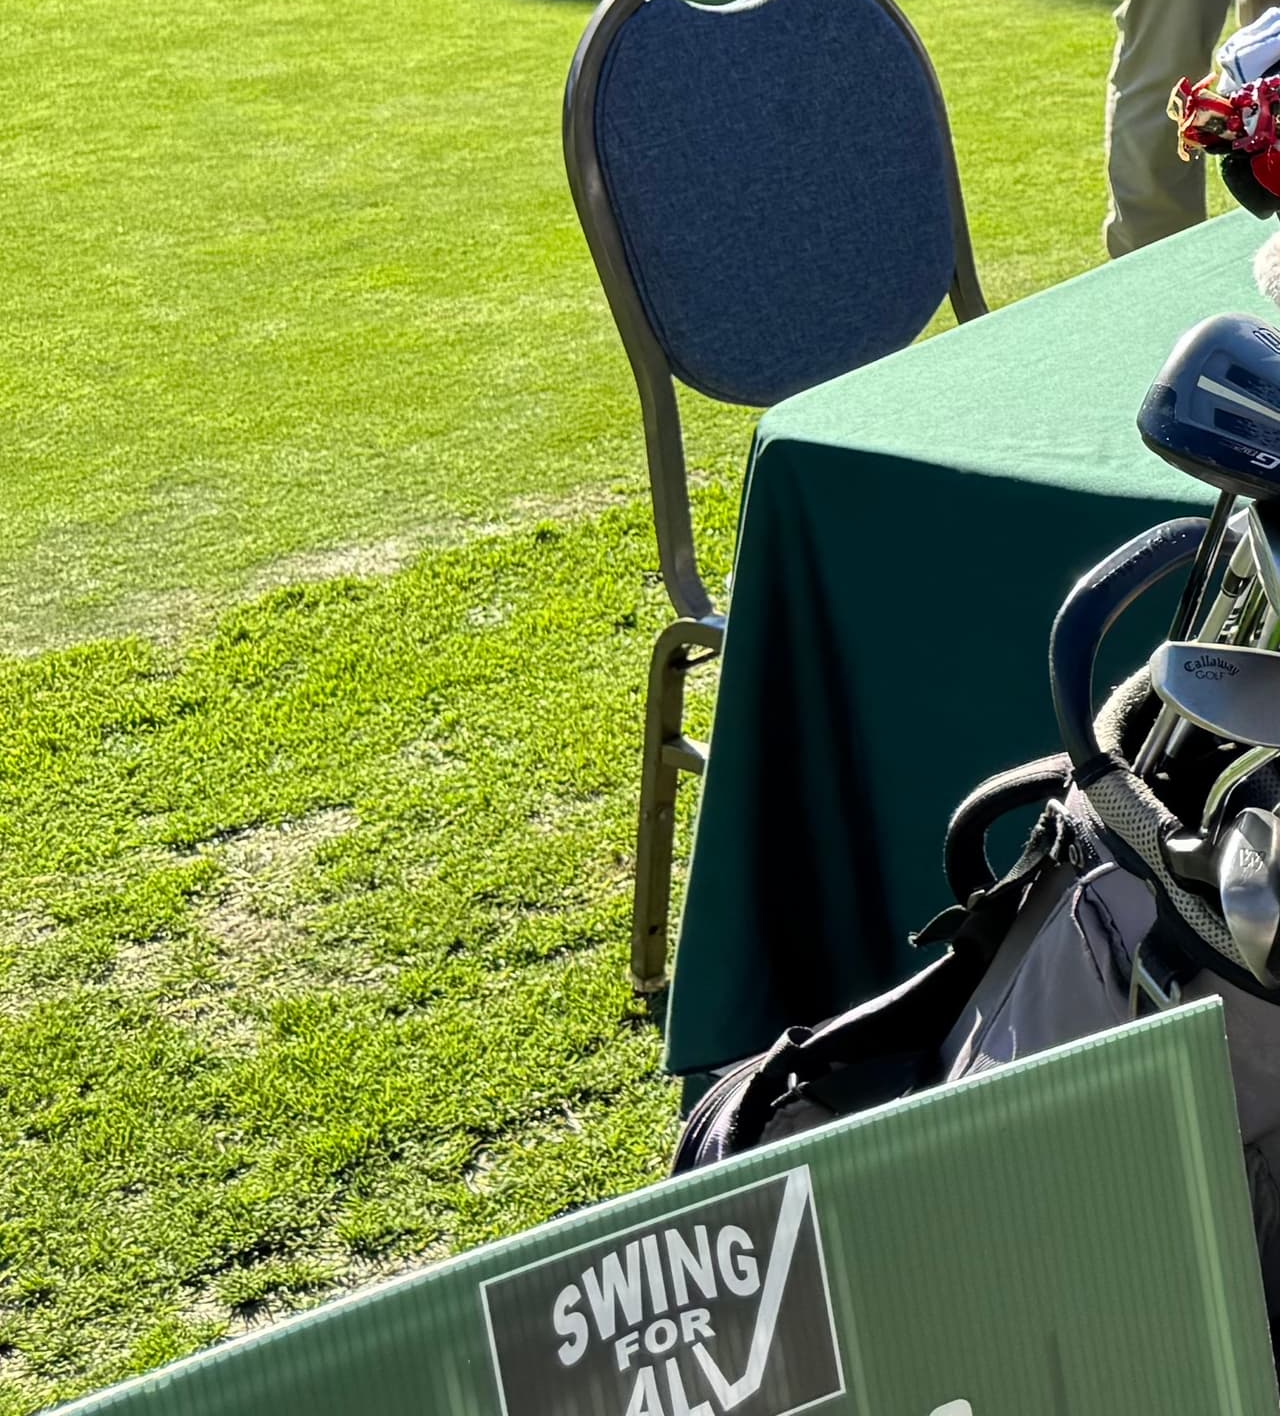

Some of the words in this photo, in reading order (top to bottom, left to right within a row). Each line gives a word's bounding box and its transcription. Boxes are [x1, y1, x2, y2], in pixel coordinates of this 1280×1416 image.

[1183, 655, 1241, 677] Callaway
[1195, 670, 1225, 681] GOLF
[552, 1224, 762, 1367] SWING
[614, 1307, 717, 1373] FOR
